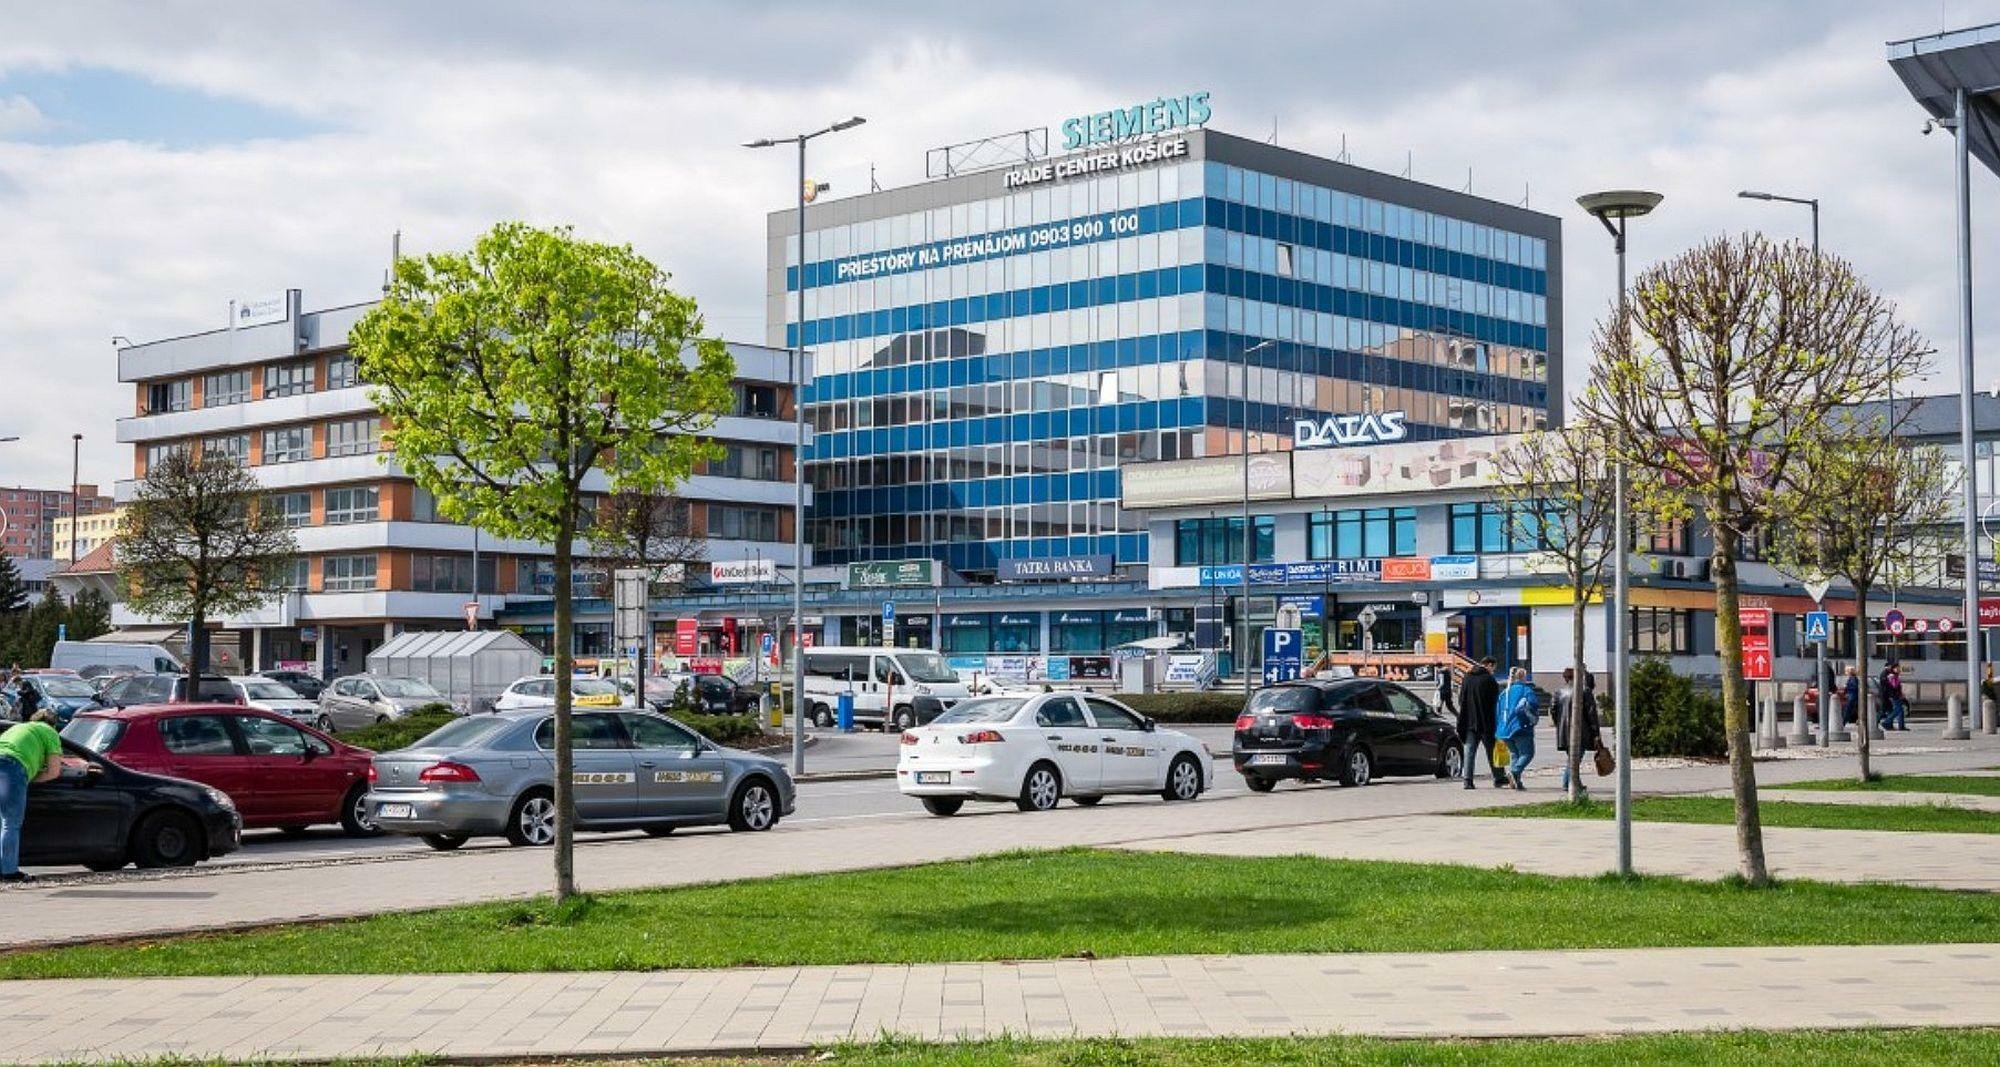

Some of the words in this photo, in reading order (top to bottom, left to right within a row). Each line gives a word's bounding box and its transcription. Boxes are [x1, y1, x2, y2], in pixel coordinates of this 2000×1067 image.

[1062, 91, 1212, 151] SIEMENS
[1056, 152, 1118, 178] CENTER
[838, 250, 916, 279] PRIESTORY
[918, 248, 940, 265] NA
[942, 233, 1027, 262] PRENÁJOM
[1030, 227, 1069, 248] 0903
[1072, 220, 1104, 240] 900
[1109, 214, 1139, 234] 100
[1294, 411, 1407, 448] DATAS
[1014, 561, 1051, 575] TATRA
[1054, 559, 1094, 573] BANKA
[1274, 631, 1291, 653] P
